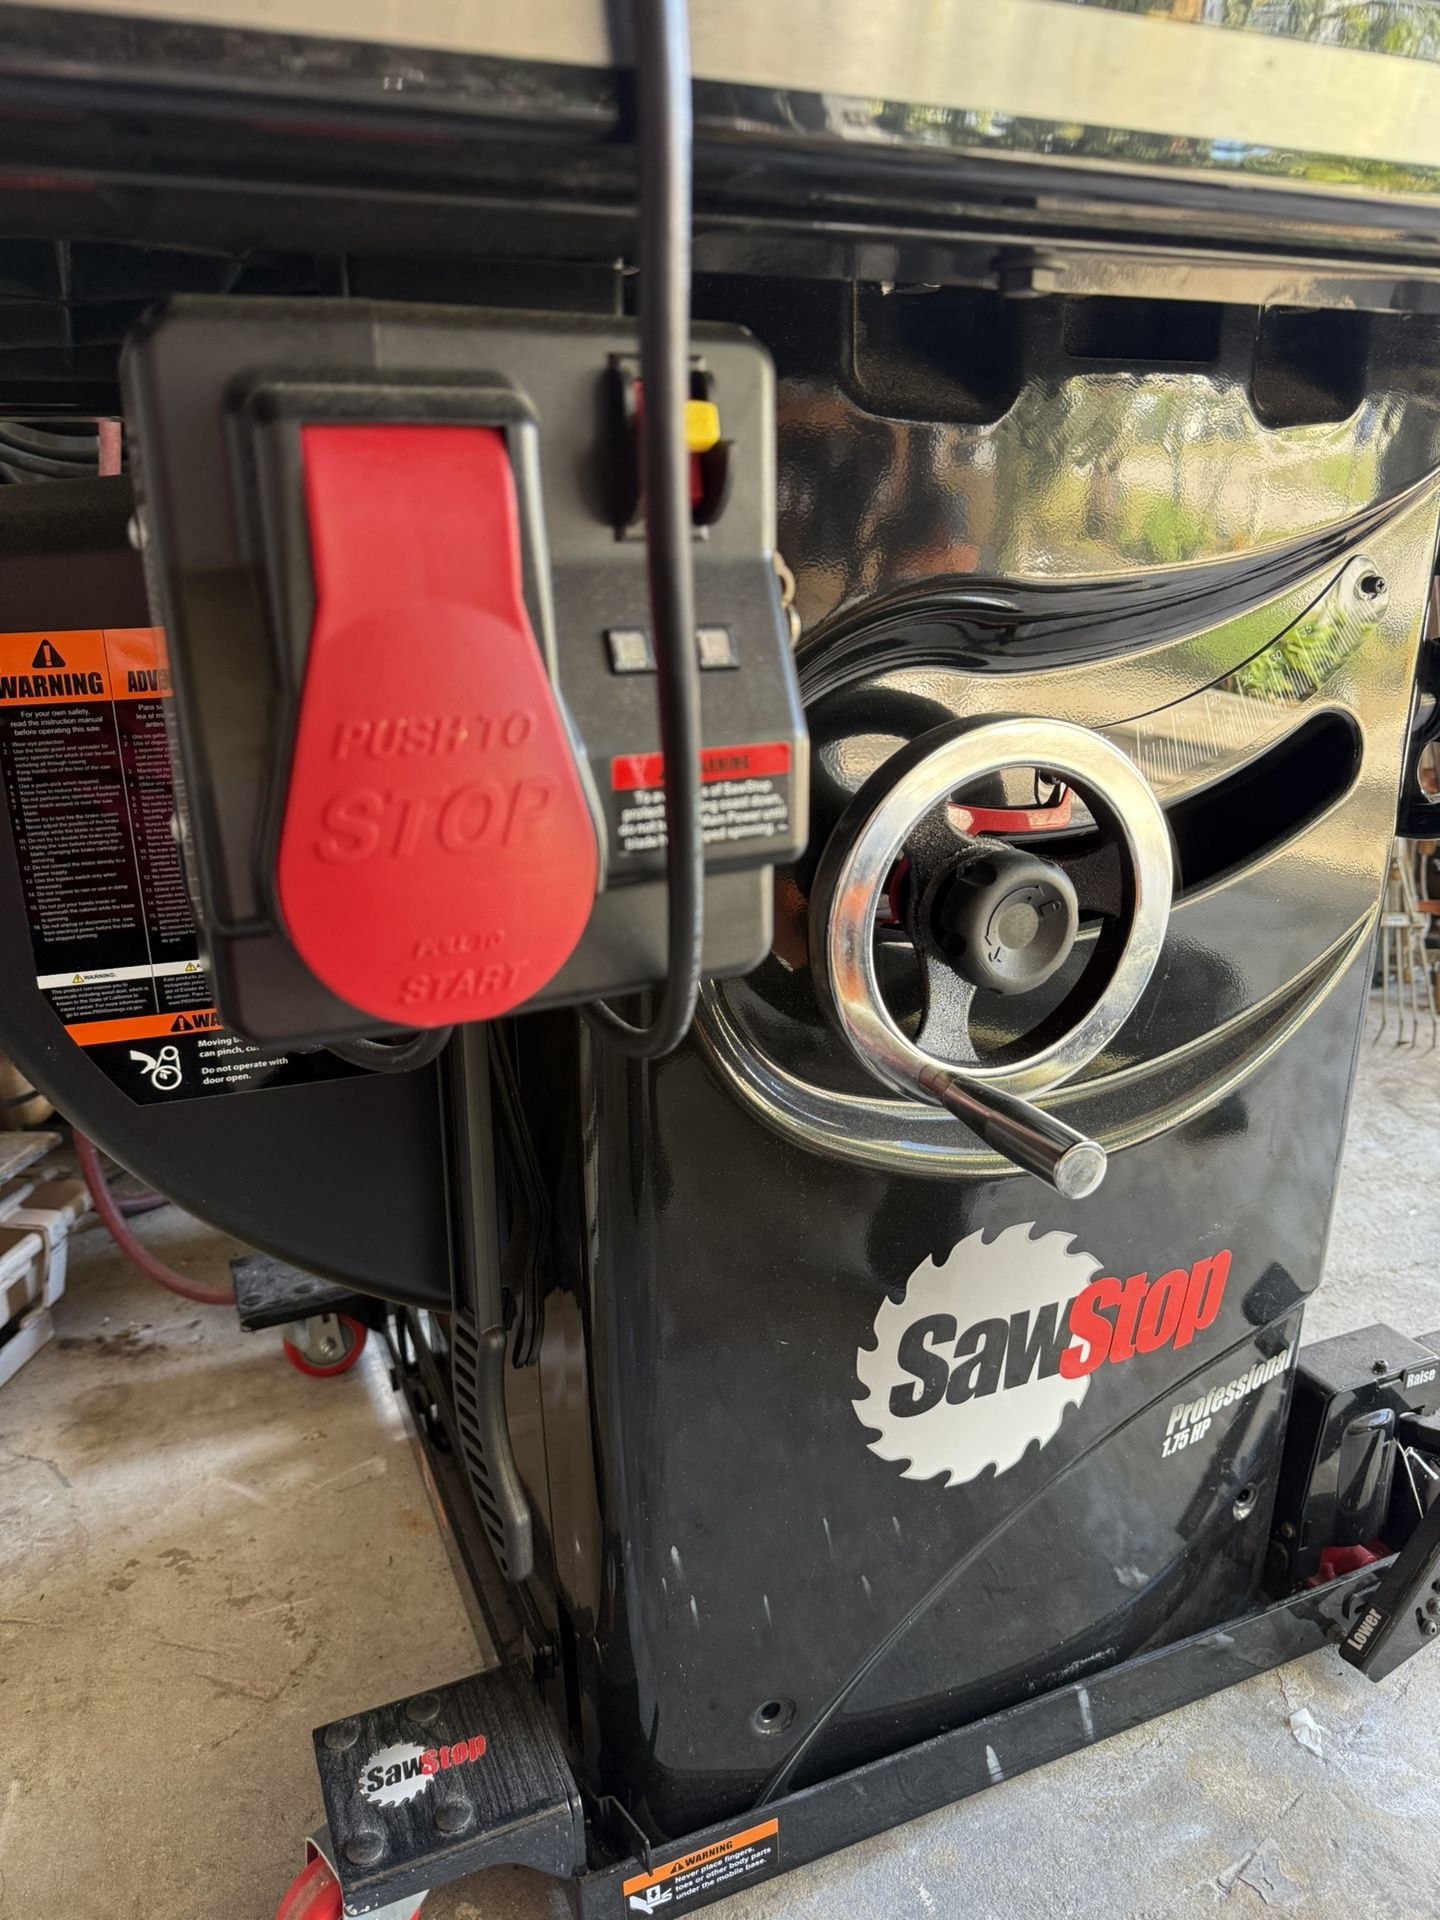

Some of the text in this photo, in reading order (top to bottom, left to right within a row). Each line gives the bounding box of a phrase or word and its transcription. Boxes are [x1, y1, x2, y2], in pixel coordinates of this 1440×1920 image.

[0, 672, 104, 699] WARNING
[332, 710, 536, 760] PUSH TO
[315, 775, 562, 864] STOP
[401, 961, 530, 1004] START
[198, 1036, 232, 1048] Moving
[200, 1050, 216, 1058] can
[217, 1046, 244, 1058] pinch,
[202, 1056, 289, 1075] Do not operate with
[203, 1073, 252, 1084] door open.
[889, 1249, 1232, 1418] SawStop
[1165, 1349, 1292, 1437] Professional
[1406, 1369, 1436, 1388] Raise
[1161, 1418, 1212, 1458] 1.75 HP
[1347, 1607, 1382, 1651] Lower
[367, 1735, 487, 1792] SawStop
[674, 1847, 755, 1884] Never place fingers,
[674, 1847, 772, 1892] toes or other body parts
[684, 1841, 733, 1867] WARNING
[676, 1858, 767, 1900] under the mobile base.
